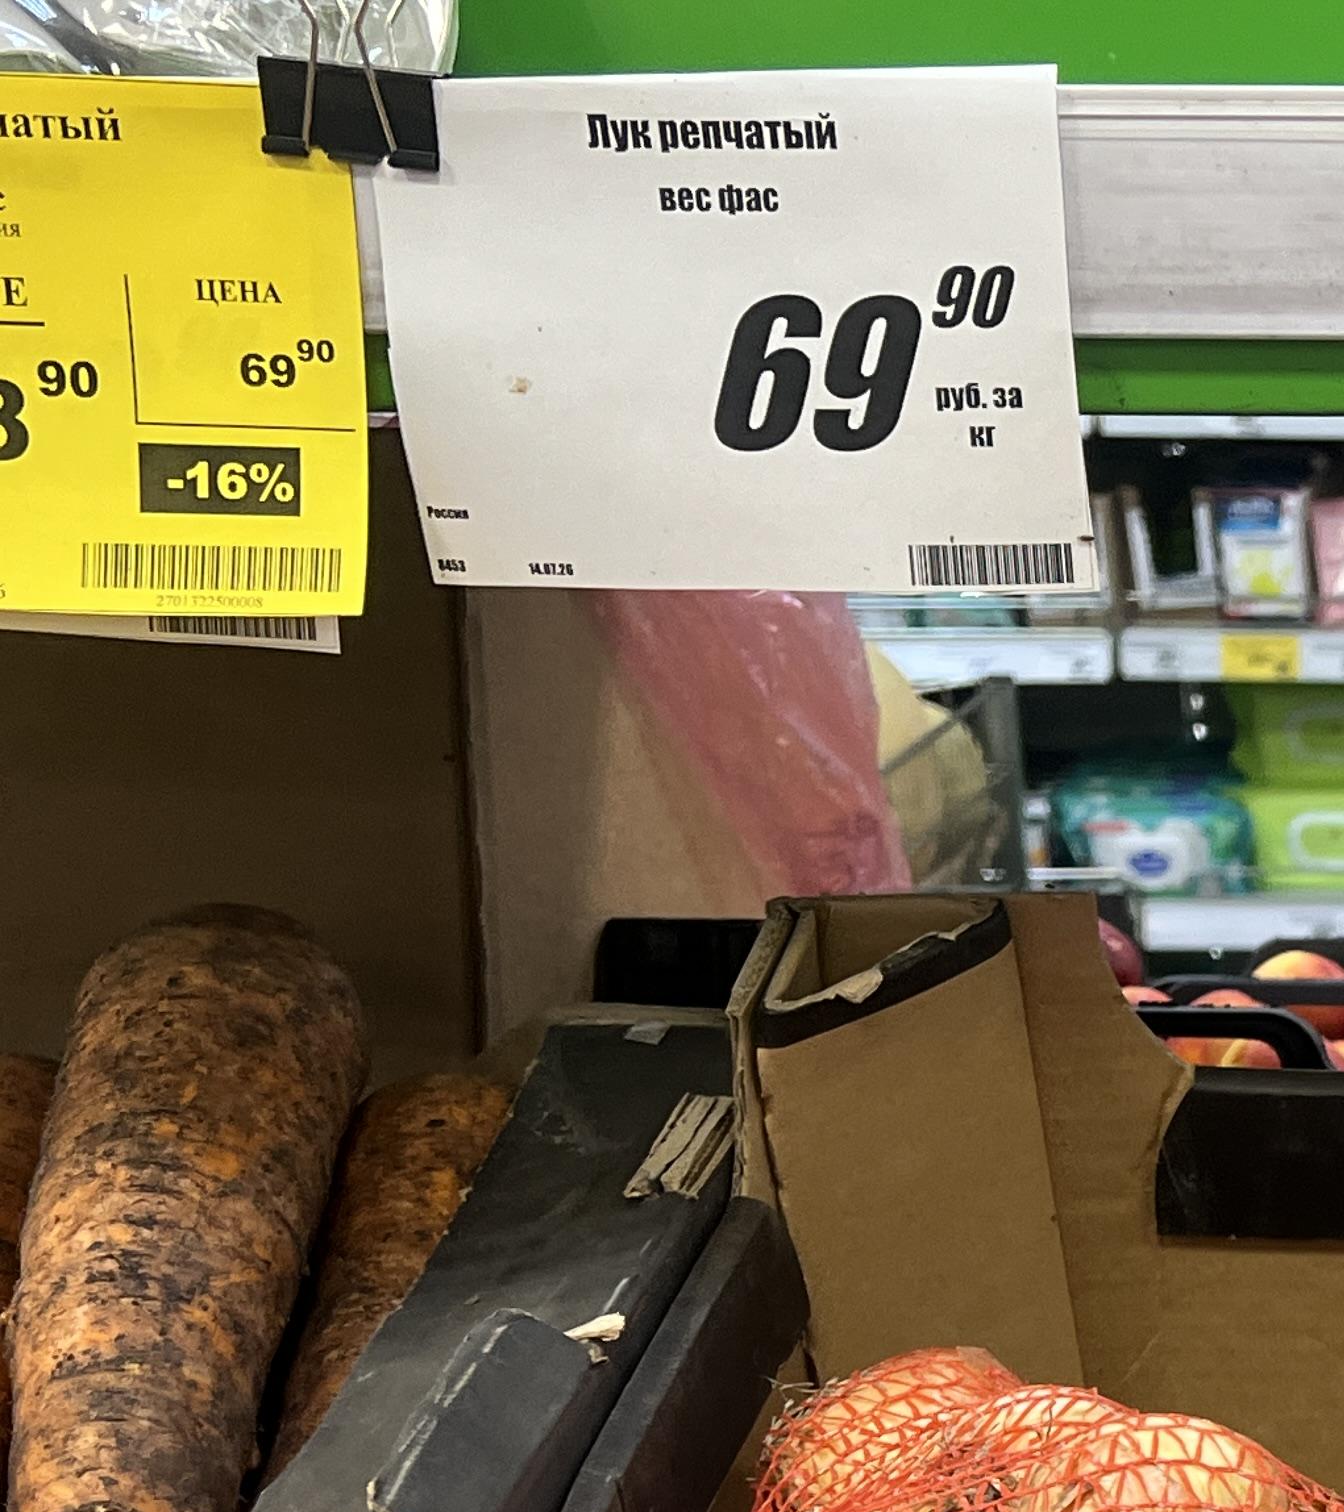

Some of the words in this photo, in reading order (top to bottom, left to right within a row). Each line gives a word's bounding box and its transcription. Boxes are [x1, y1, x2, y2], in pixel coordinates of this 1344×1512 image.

[586, 113, 653, 153] Лук
[657, 112, 838, 153] репчатый
[658, 187, 712, 212] вес
[718, 183, 779, 216] фас
[195, 278, 283, 306] ЦЕНА
[240, 353, 296, 388] 69
[296, 338, 335, 363] 90
[714, 294, 922, 452] 69
[931, 265, 1015, 329] 90
[37, 359, 98, 398] 90
[935, 382, 988, 412] руб.
[992, 386, 1024, 409] за
[969, 425, 996, 448] кг
[166, 460, 296, 503] -16%
[426, 505, 470, 520] Россия
[155, 594, 264, 609] 2701322500008
